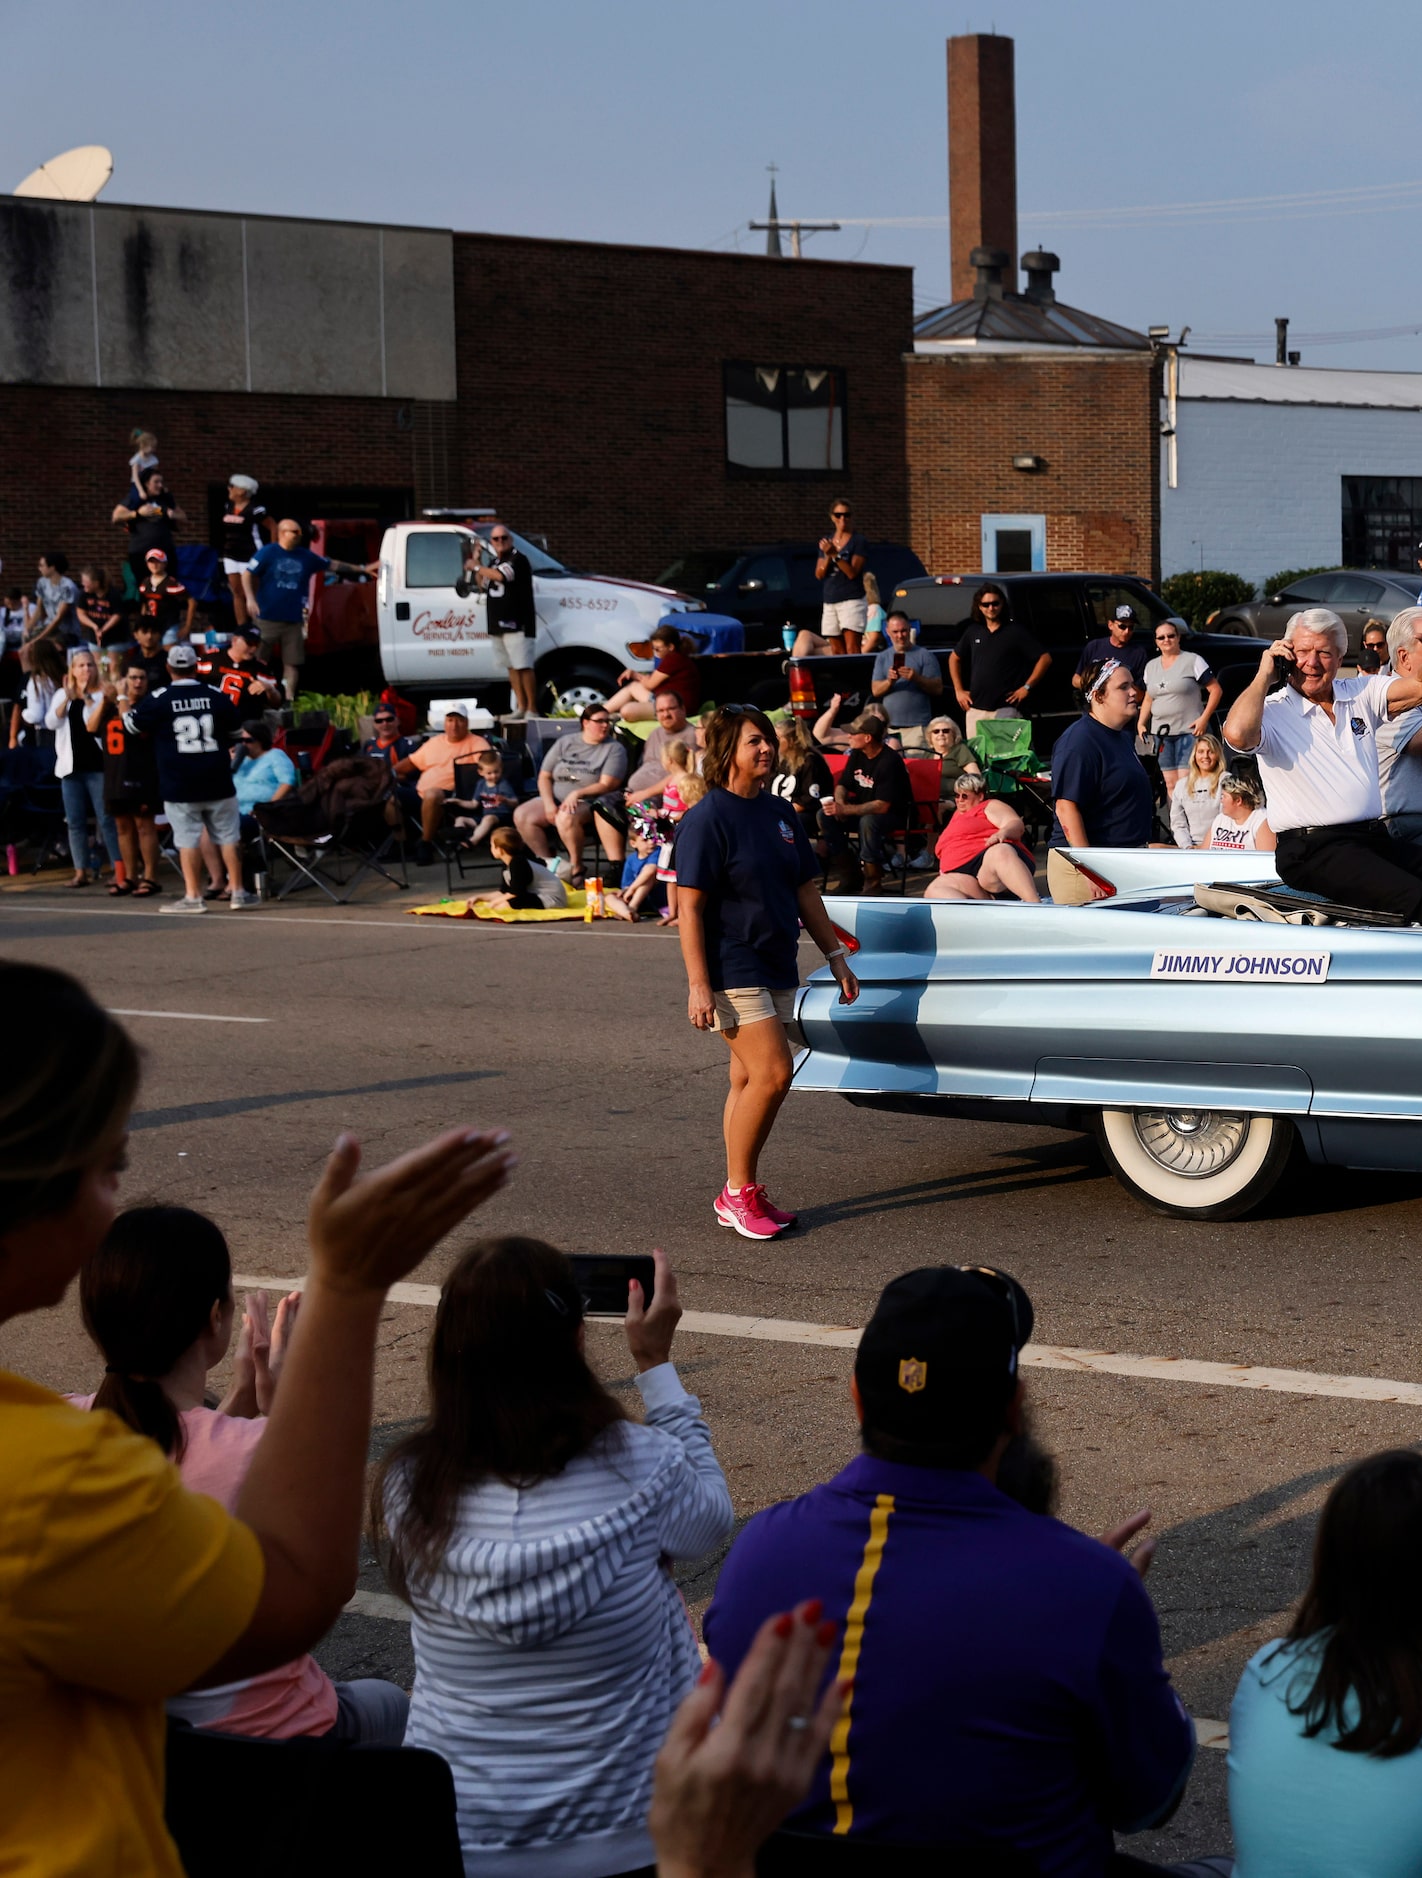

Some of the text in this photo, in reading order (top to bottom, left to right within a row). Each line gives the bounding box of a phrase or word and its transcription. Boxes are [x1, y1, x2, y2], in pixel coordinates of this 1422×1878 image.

[171, 698, 212, 712] ELLIOTT
[106, 719, 125, 755] 6
[172, 713, 219, 753] 21
[1157, 955, 1323, 975] JIMMY JOHNSON
